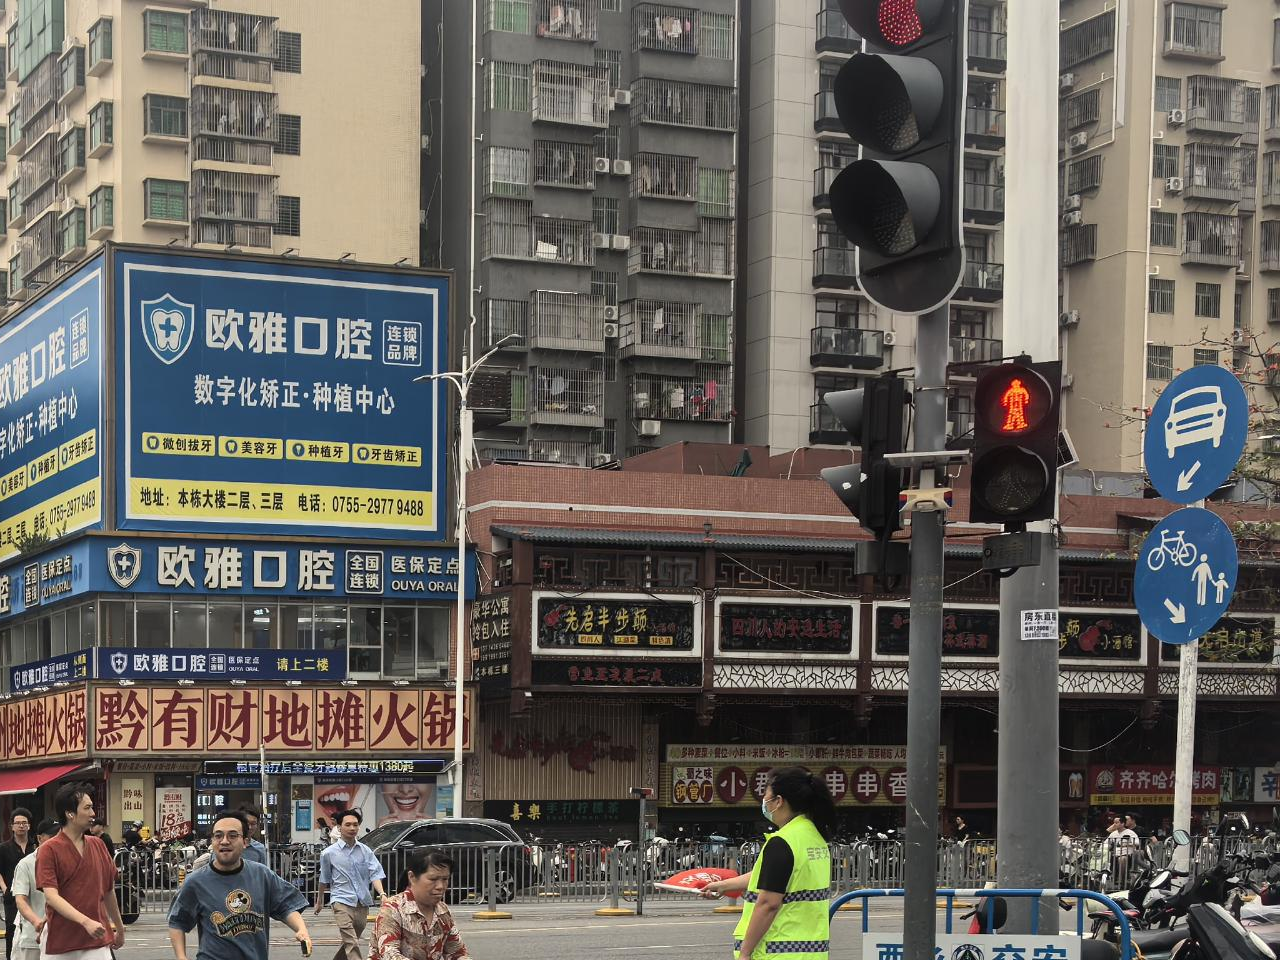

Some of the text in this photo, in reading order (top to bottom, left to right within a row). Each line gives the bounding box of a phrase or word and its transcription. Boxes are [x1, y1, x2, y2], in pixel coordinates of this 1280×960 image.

[205, 308, 373, 361] 欧雅口腔
[387, 325, 418, 343] 连锁
[387, 344, 418, 361] 品牌
[194, 374, 396, 415] 数字化矫正·种植中心
[162, 437, 418, 462] 微创拔牙 美容牙 种植牙 牙齿矫正
[41, 555, 72, 581] 医保定点
[158, 545, 335, 590] 欧雅口腔
[350, 555, 379, 571] 全国
[391, 556, 460, 574] 医保定点
[350, 573, 379, 589] 连锁
[391, 580, 425, 592] OUYA
[133, 654, 206, 673] 欧雅口腔
[228, 656, 260, 665] 医保定点
[276, 657, 329, 672] 请上二楼
[21, 665, 48, 687] 欧雅口腔
[96, 688, 470, 751] 黔有财地摊火锅
[686, 768, 712, 780] 蜀之味
[123, 801, 143, 811] 出山
